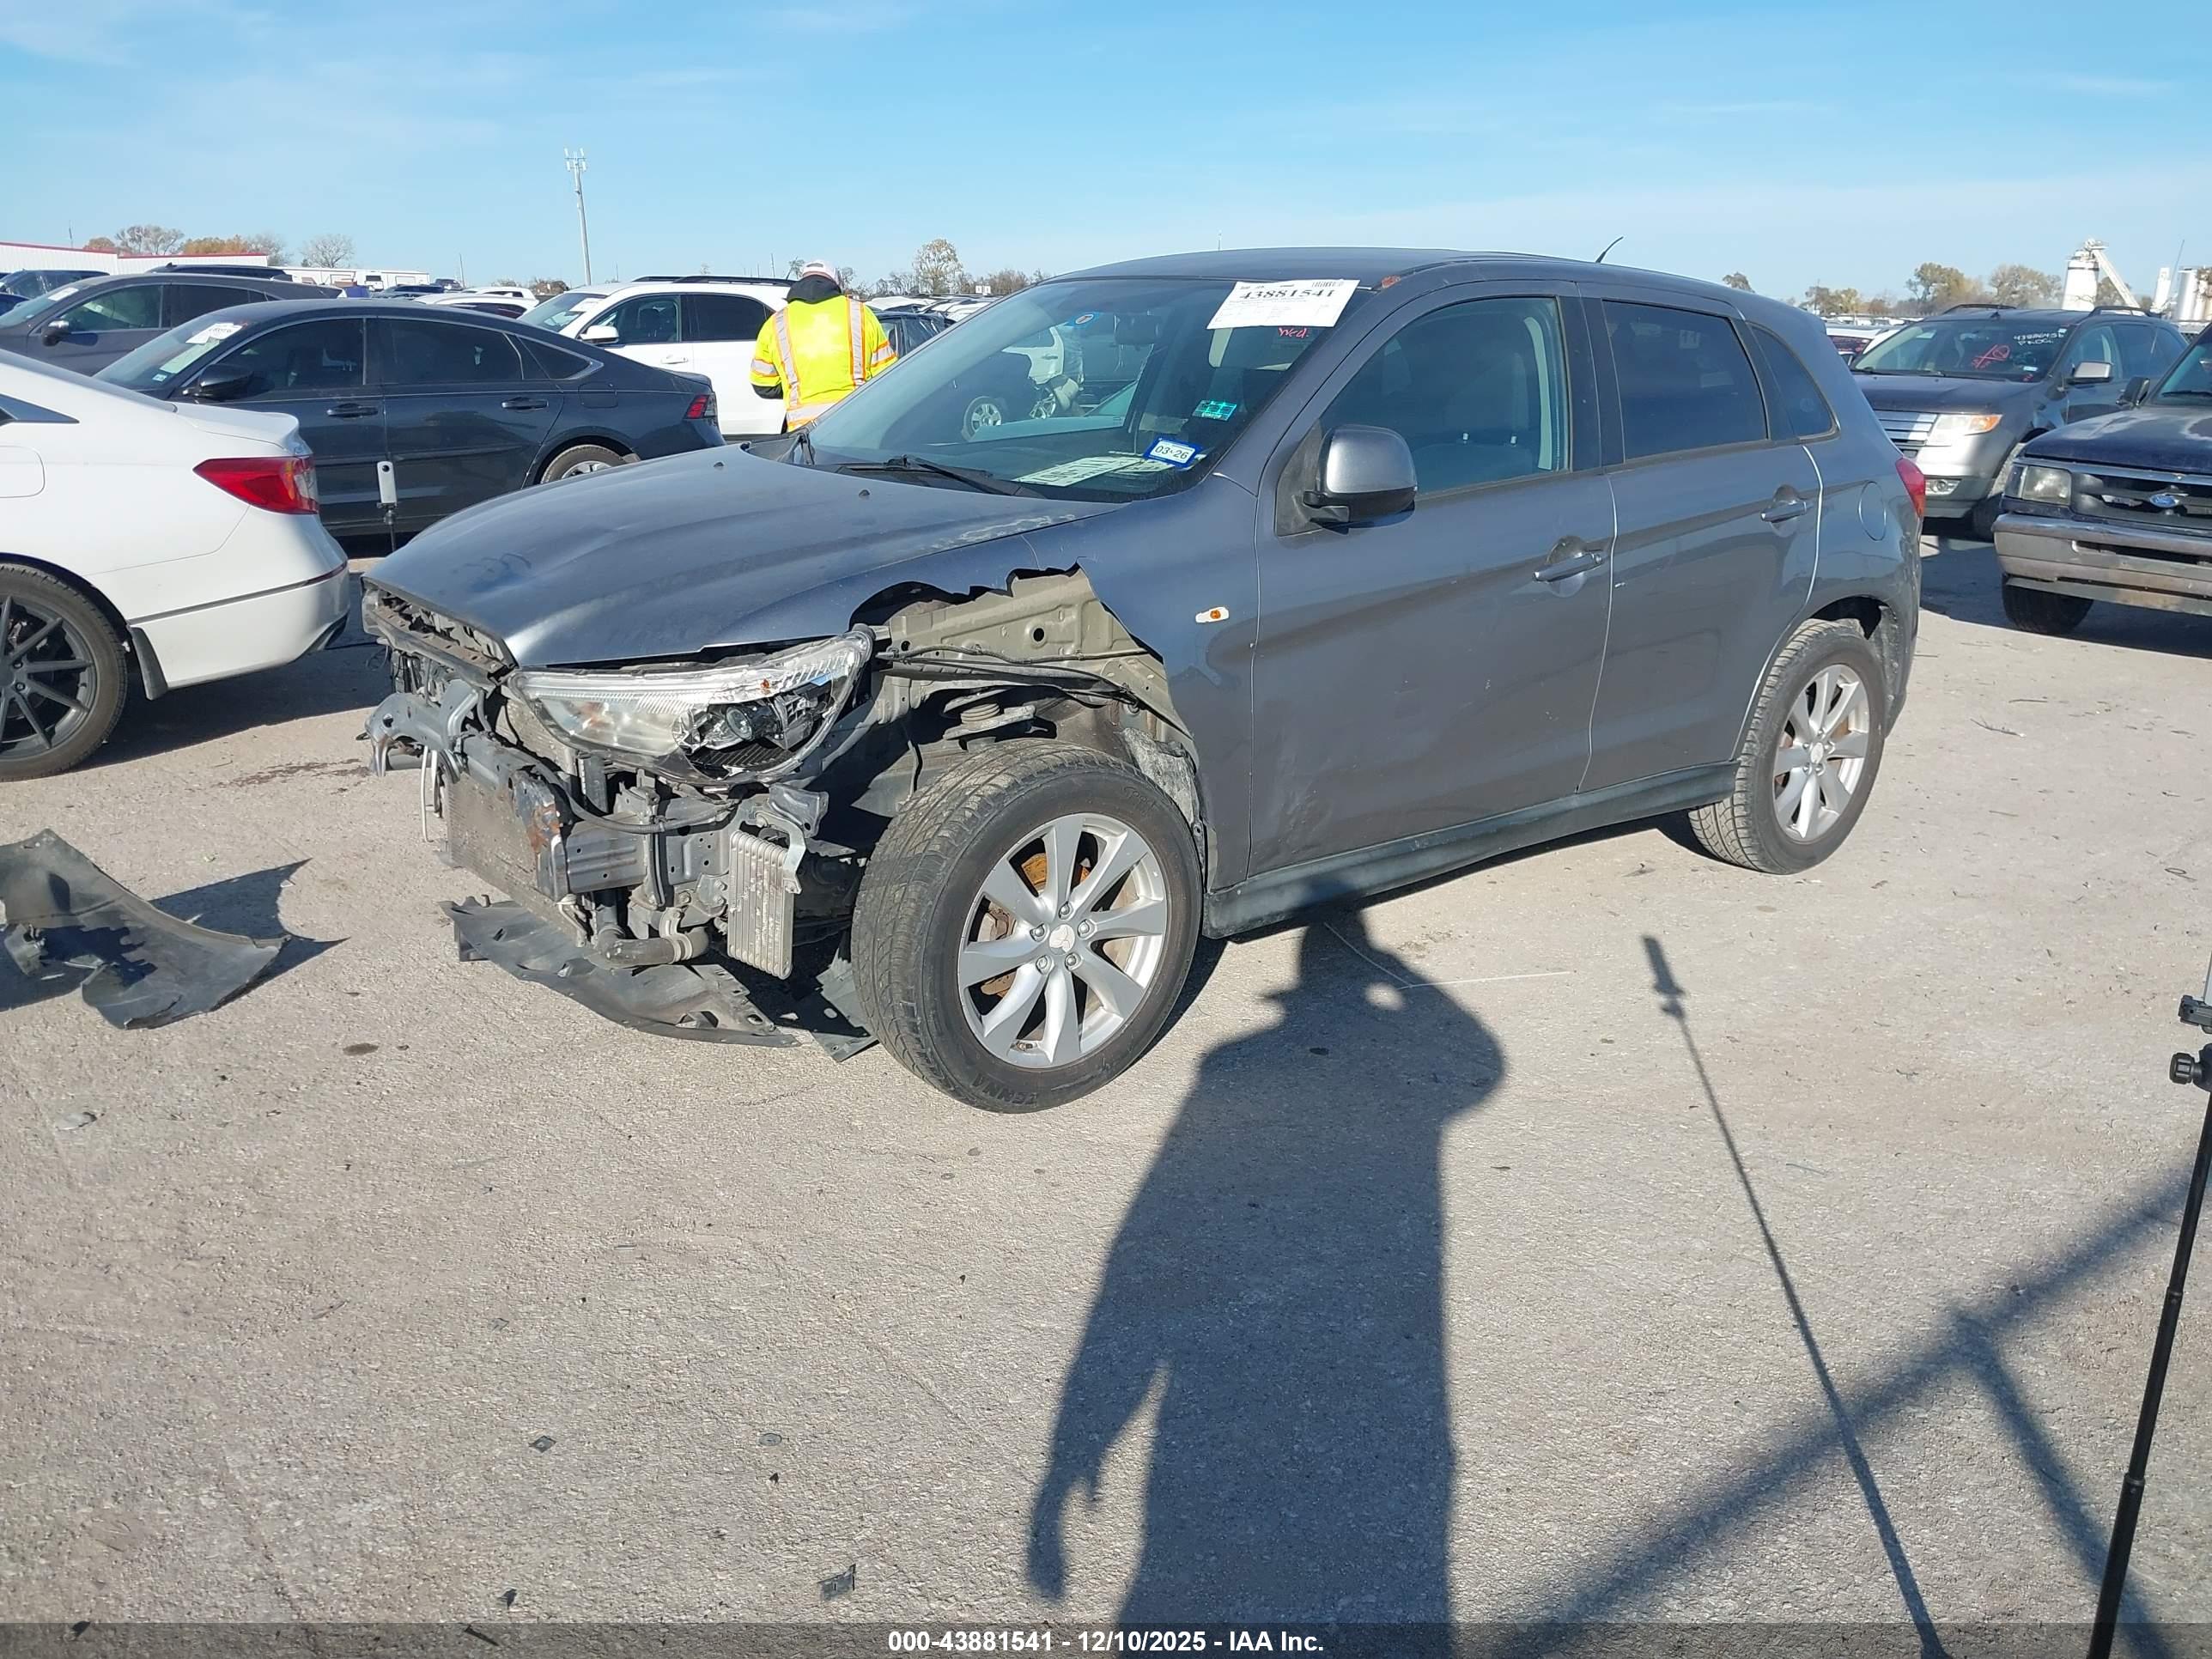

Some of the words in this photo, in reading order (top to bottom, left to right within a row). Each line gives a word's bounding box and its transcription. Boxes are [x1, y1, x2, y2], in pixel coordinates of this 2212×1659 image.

[1239, 289, 1335, 299] 43881541
[1154, 446, 1170, 454] 03
[1173, 449, 1189, 459] 26
